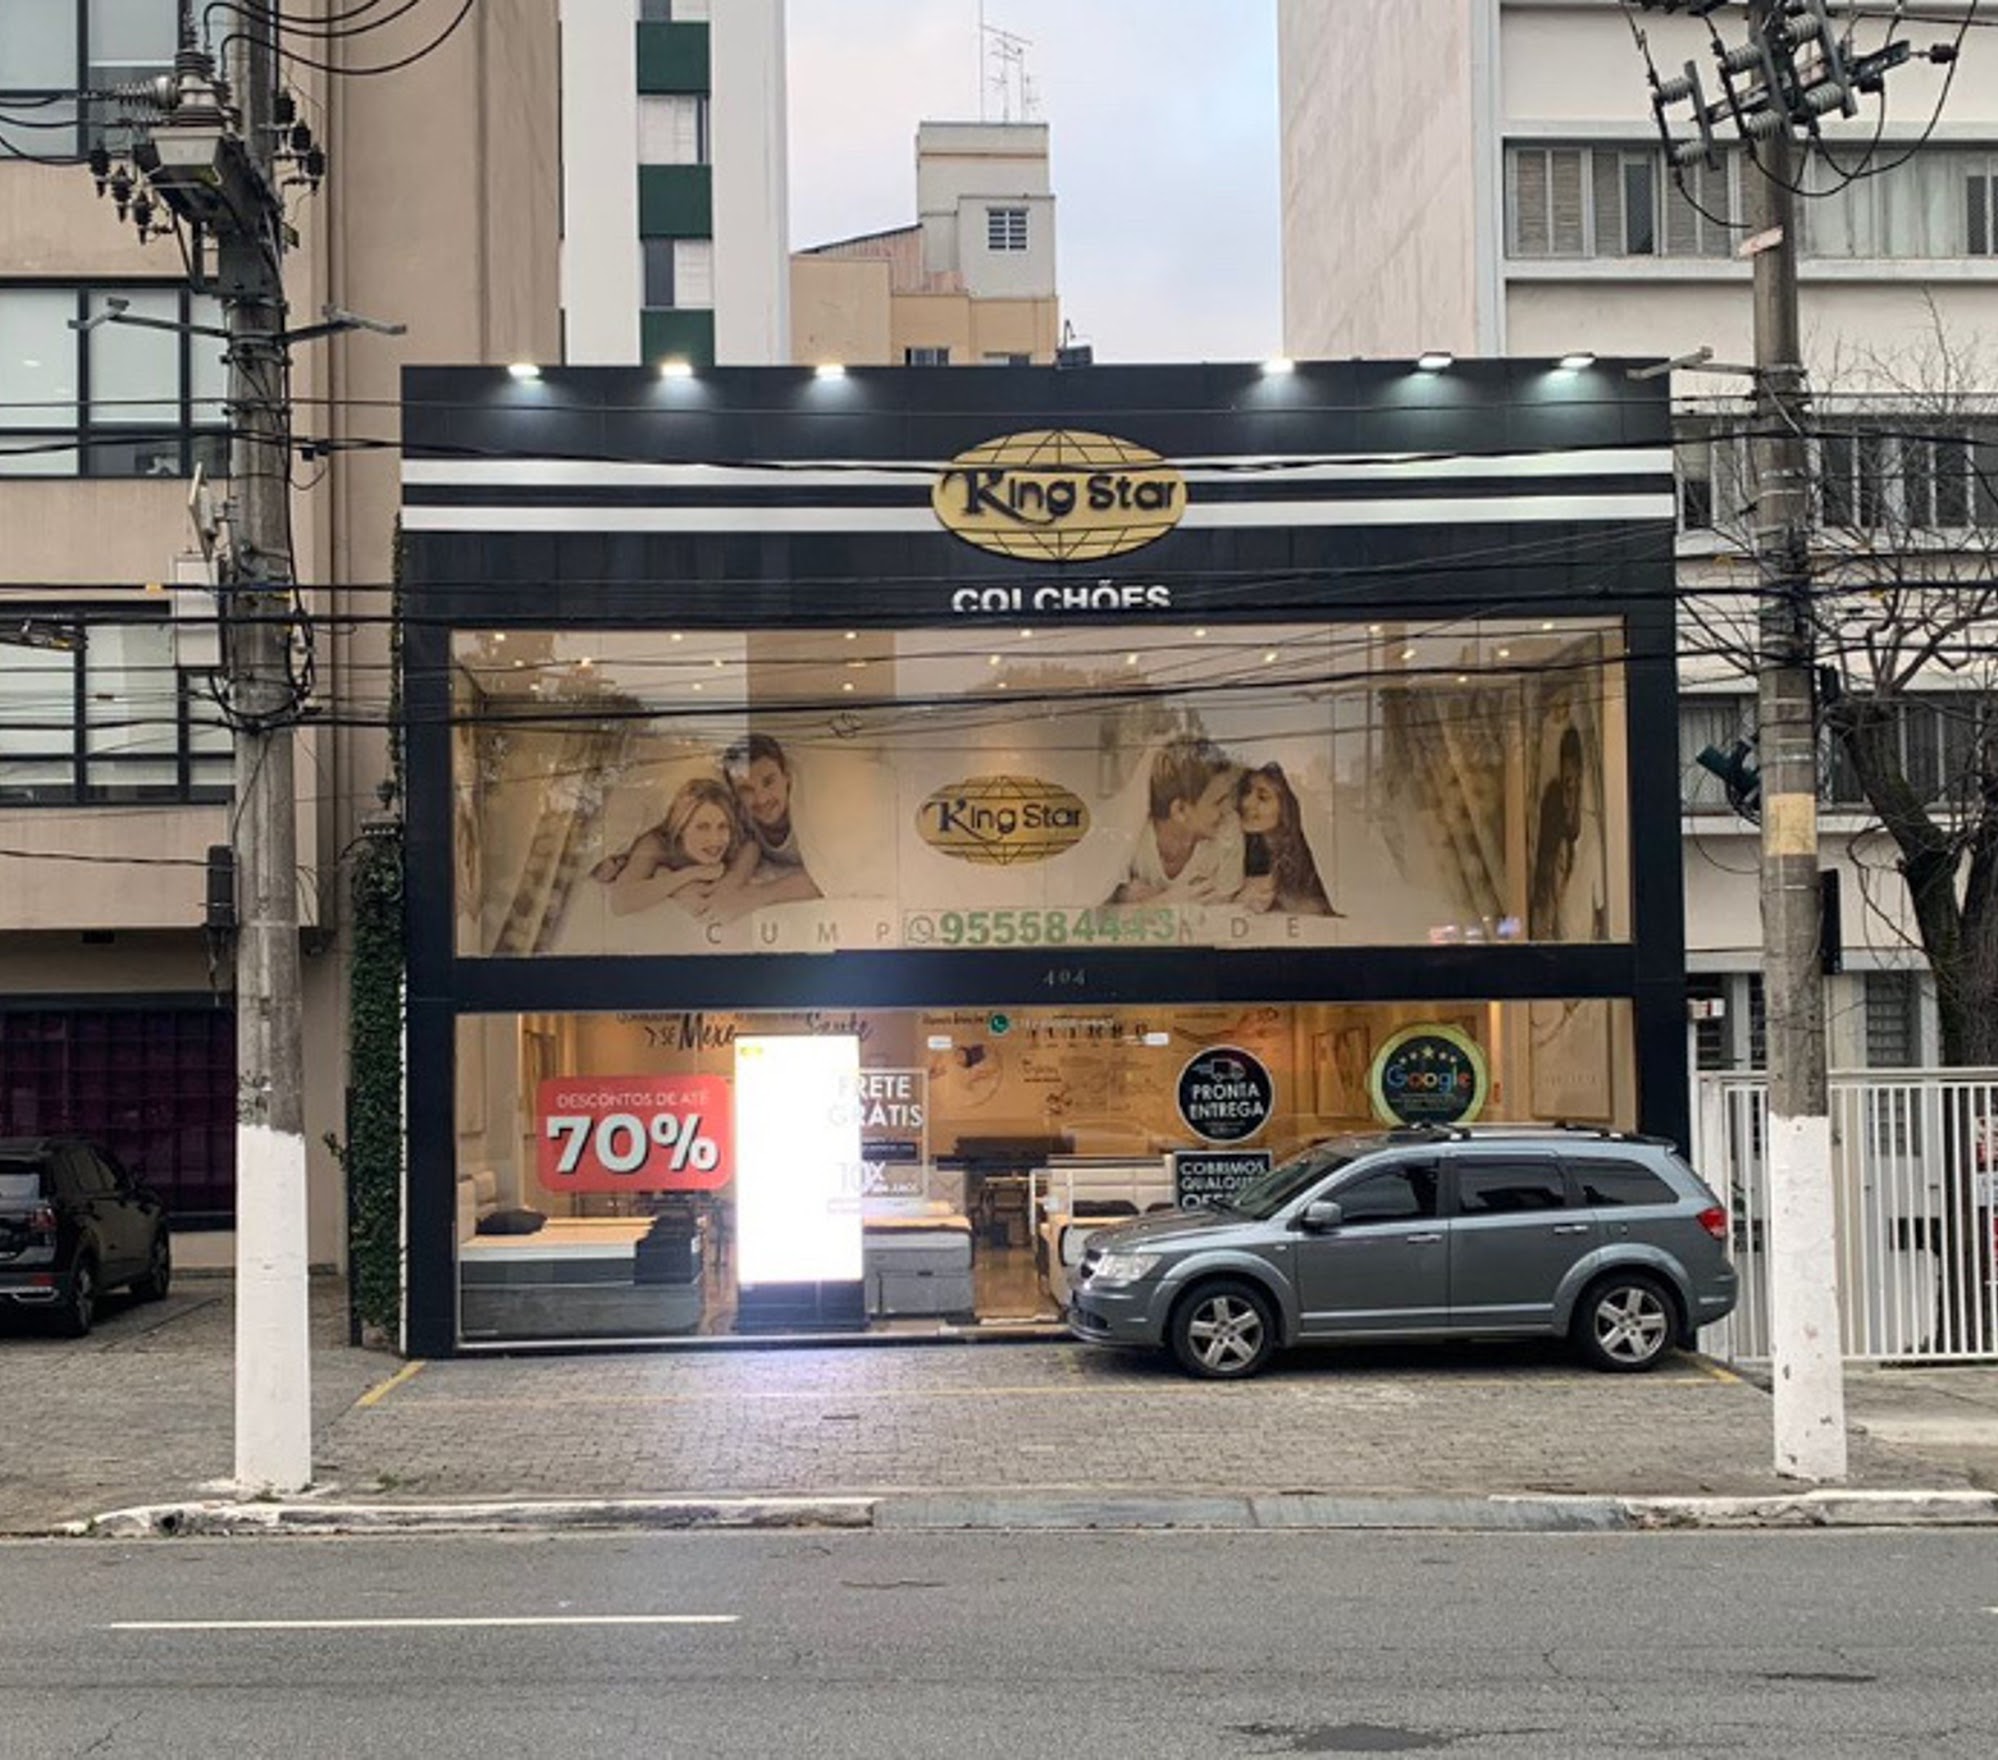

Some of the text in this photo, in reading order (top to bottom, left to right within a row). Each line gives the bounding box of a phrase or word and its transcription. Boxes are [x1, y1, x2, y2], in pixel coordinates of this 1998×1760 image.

[941, 469, 1177, 525] King Star
[922, 799, 1083, 843] King Star
[1192, 1082, 1261, 1100] PRONTA
[1386, 1063, 1472, 1094] Google
[557, 1092, 651, 1109] DESCONTOS
[656, 1092, 677, 1106] DE
[1189, 1101, 1264, 1120] ENTREGA
[546, 1112, 720, 1174] 70%
[1180, 1160, 1266, 1176] COBRIMOS
